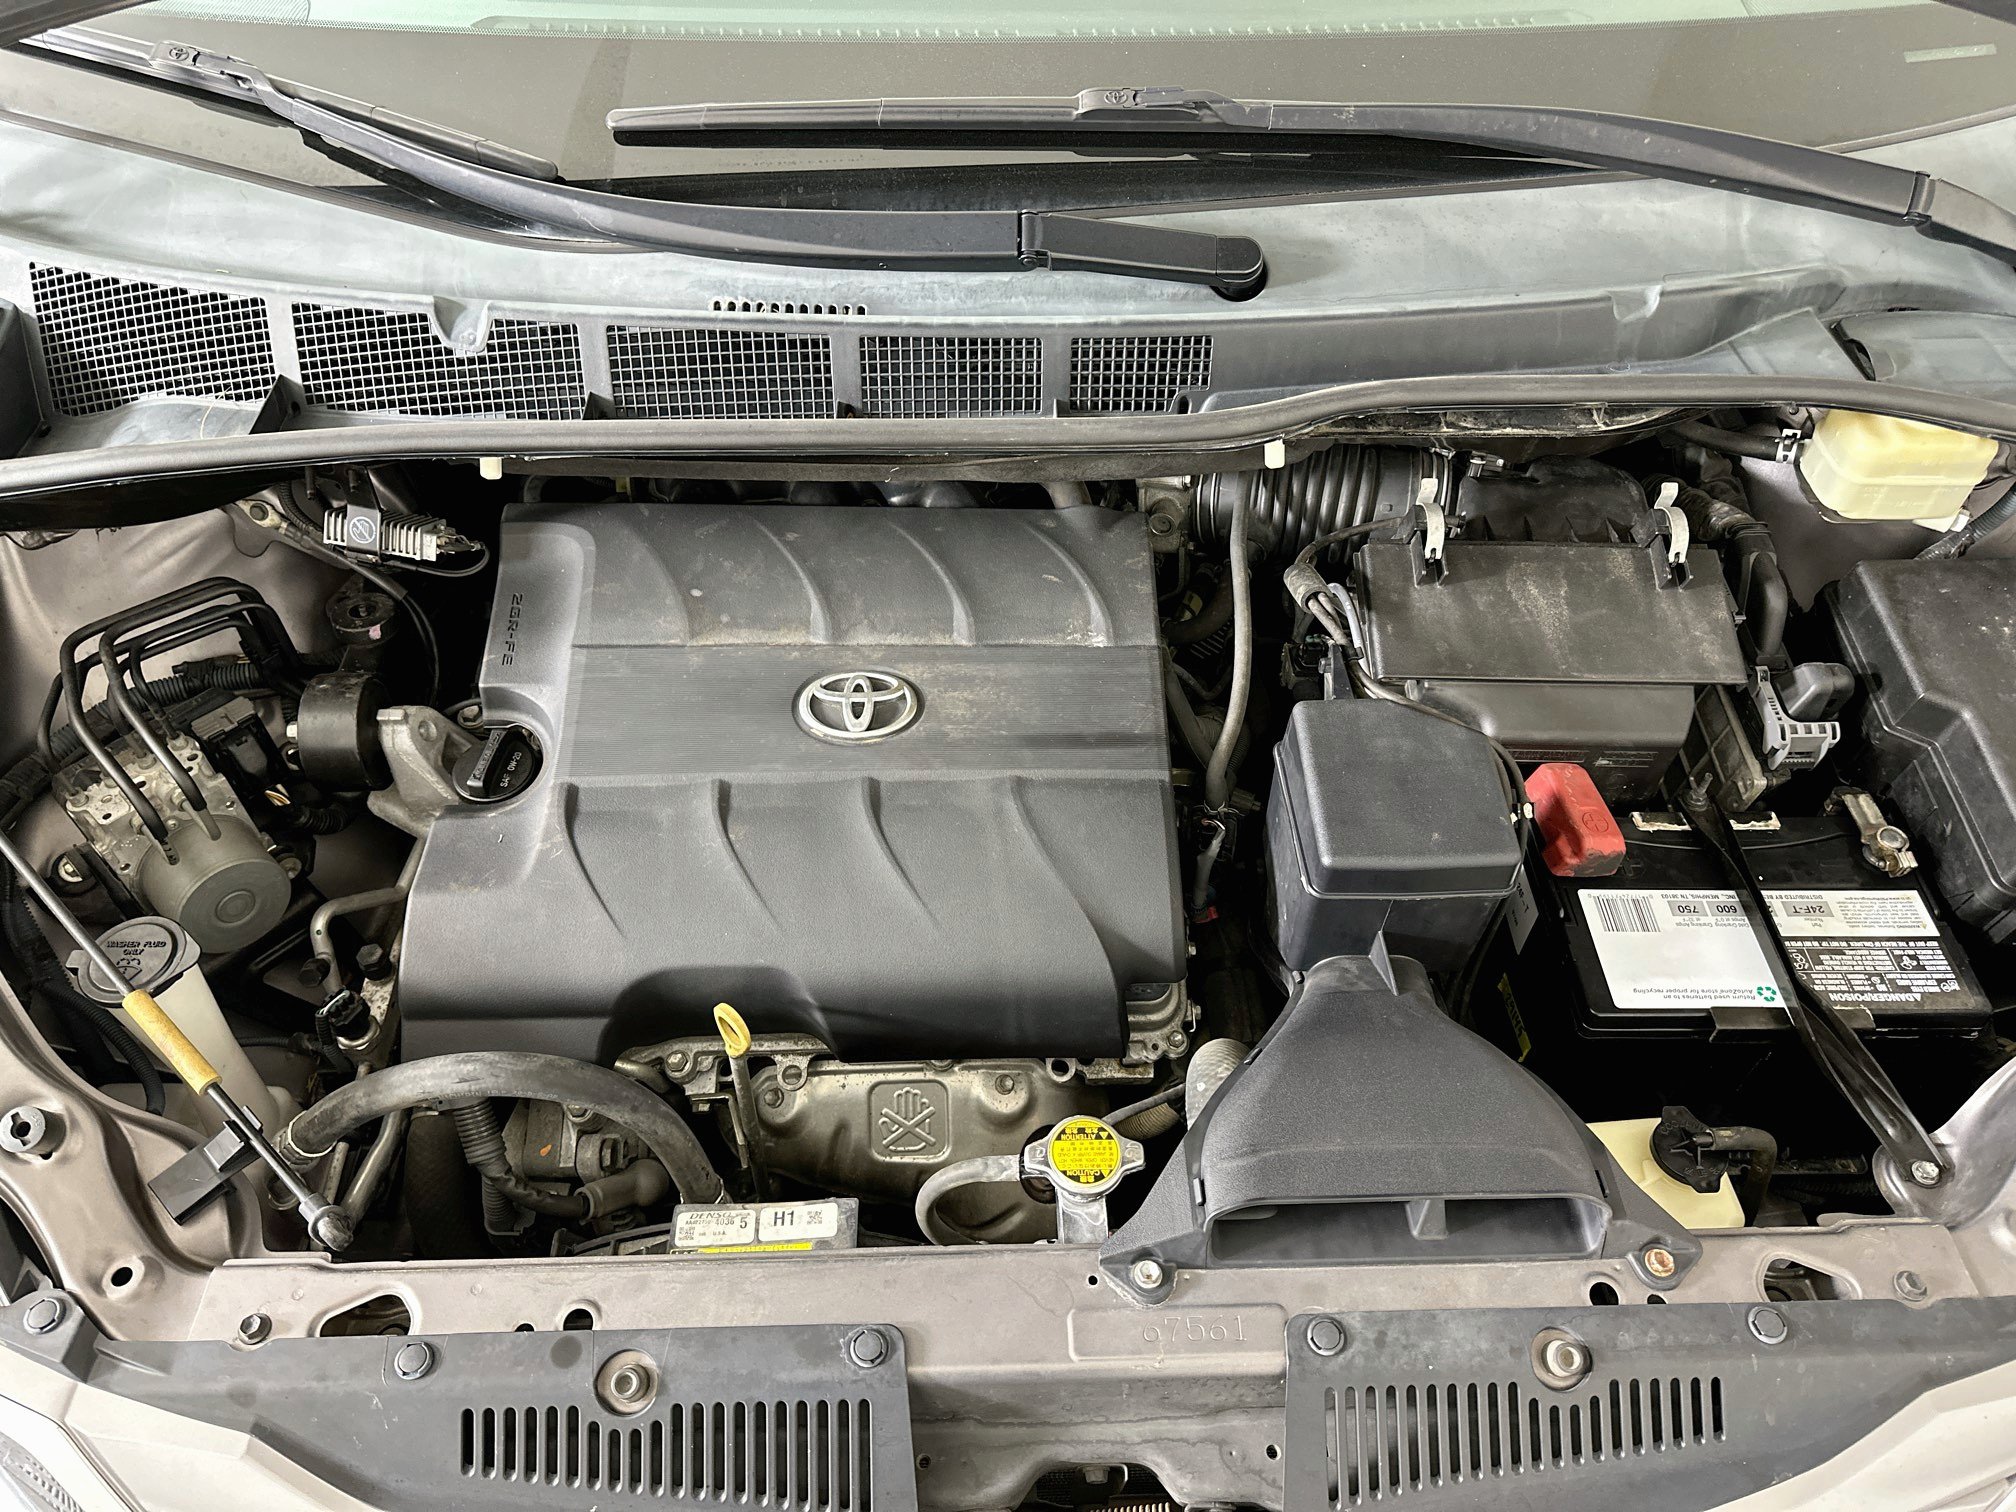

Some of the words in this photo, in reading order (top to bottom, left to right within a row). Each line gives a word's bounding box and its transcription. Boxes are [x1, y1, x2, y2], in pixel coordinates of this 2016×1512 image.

[501, 593, 523, 666] 2GR-FE
[1678, 905, 1699, 913] 750
[1716, 905, 1737, 913] 600
[1829, 993, 1913, 1001] DANGER/POISON
[740, 1217, 747, 1229] 5
[773, 1211, 795, 1227] H1
[1142, 1314, 1247, 1343] 67561
